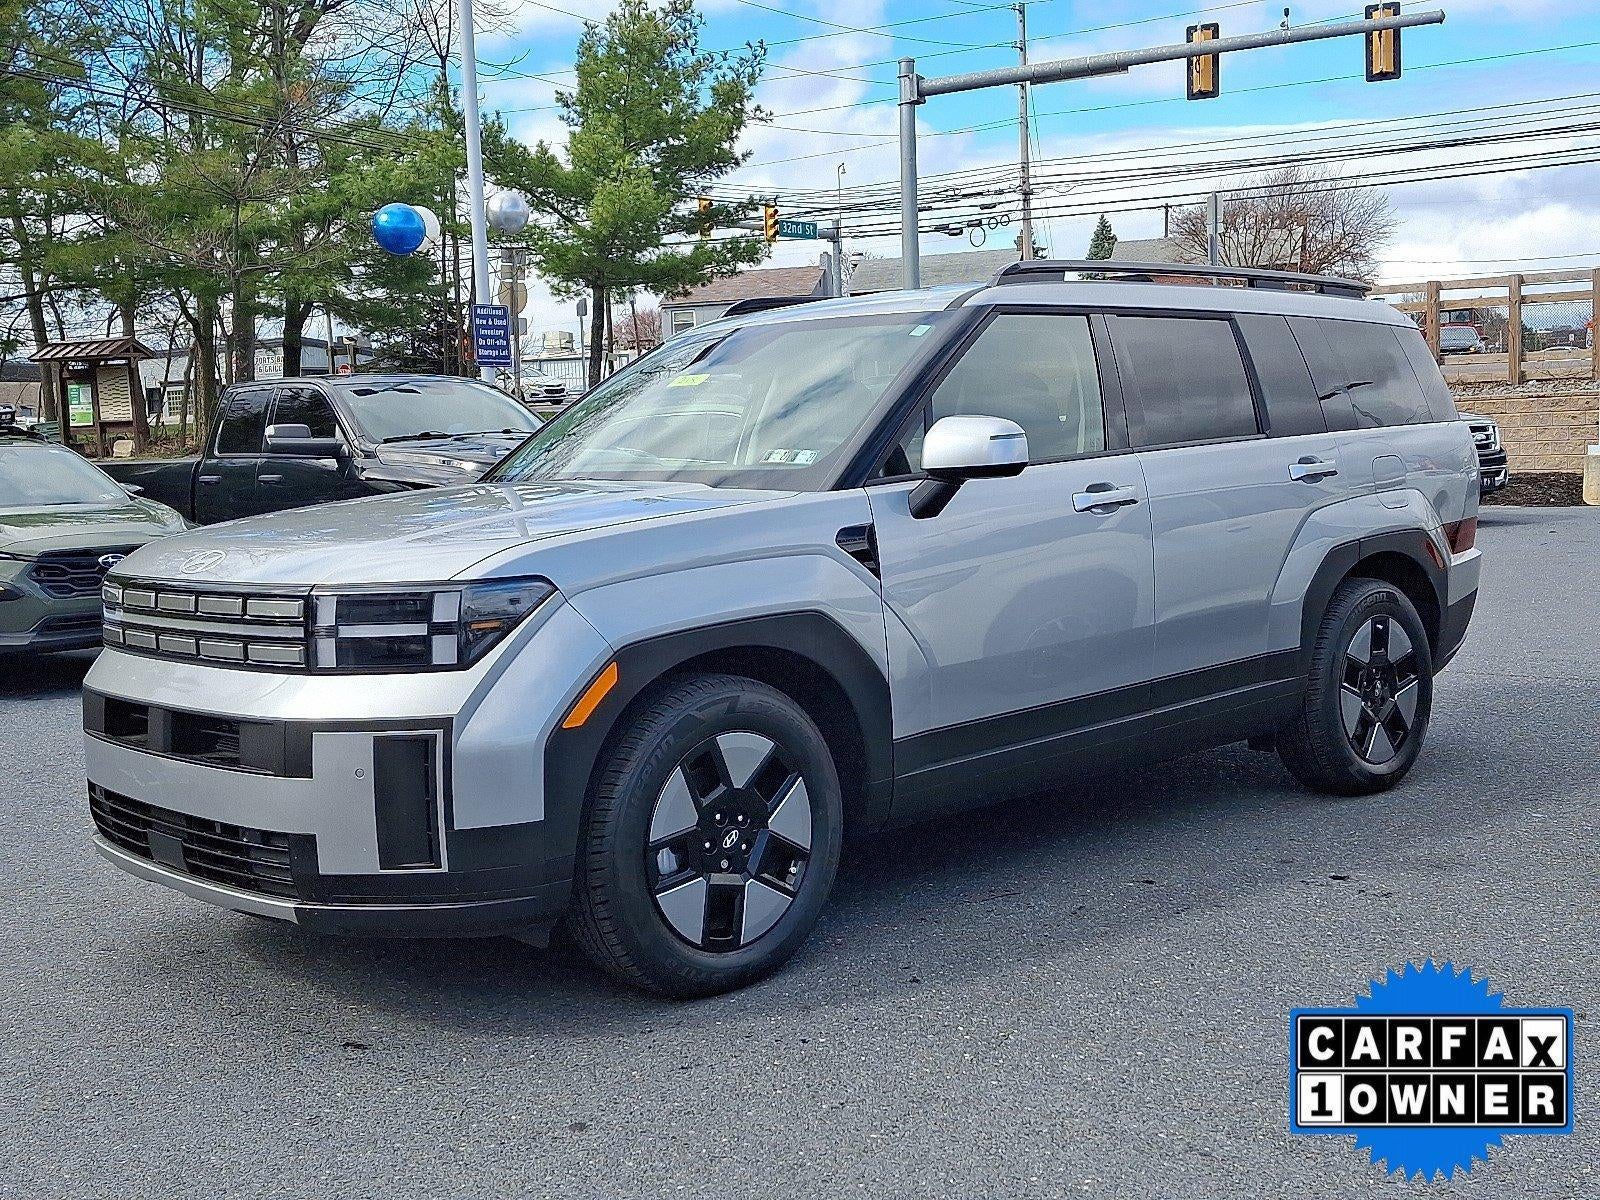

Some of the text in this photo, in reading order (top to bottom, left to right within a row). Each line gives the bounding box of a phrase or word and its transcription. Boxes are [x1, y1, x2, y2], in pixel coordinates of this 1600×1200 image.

[782, 222, 814, 236] 32nd St
[494, 318, 507, 326] Used
[479, 328, 505, 337] Inventory
